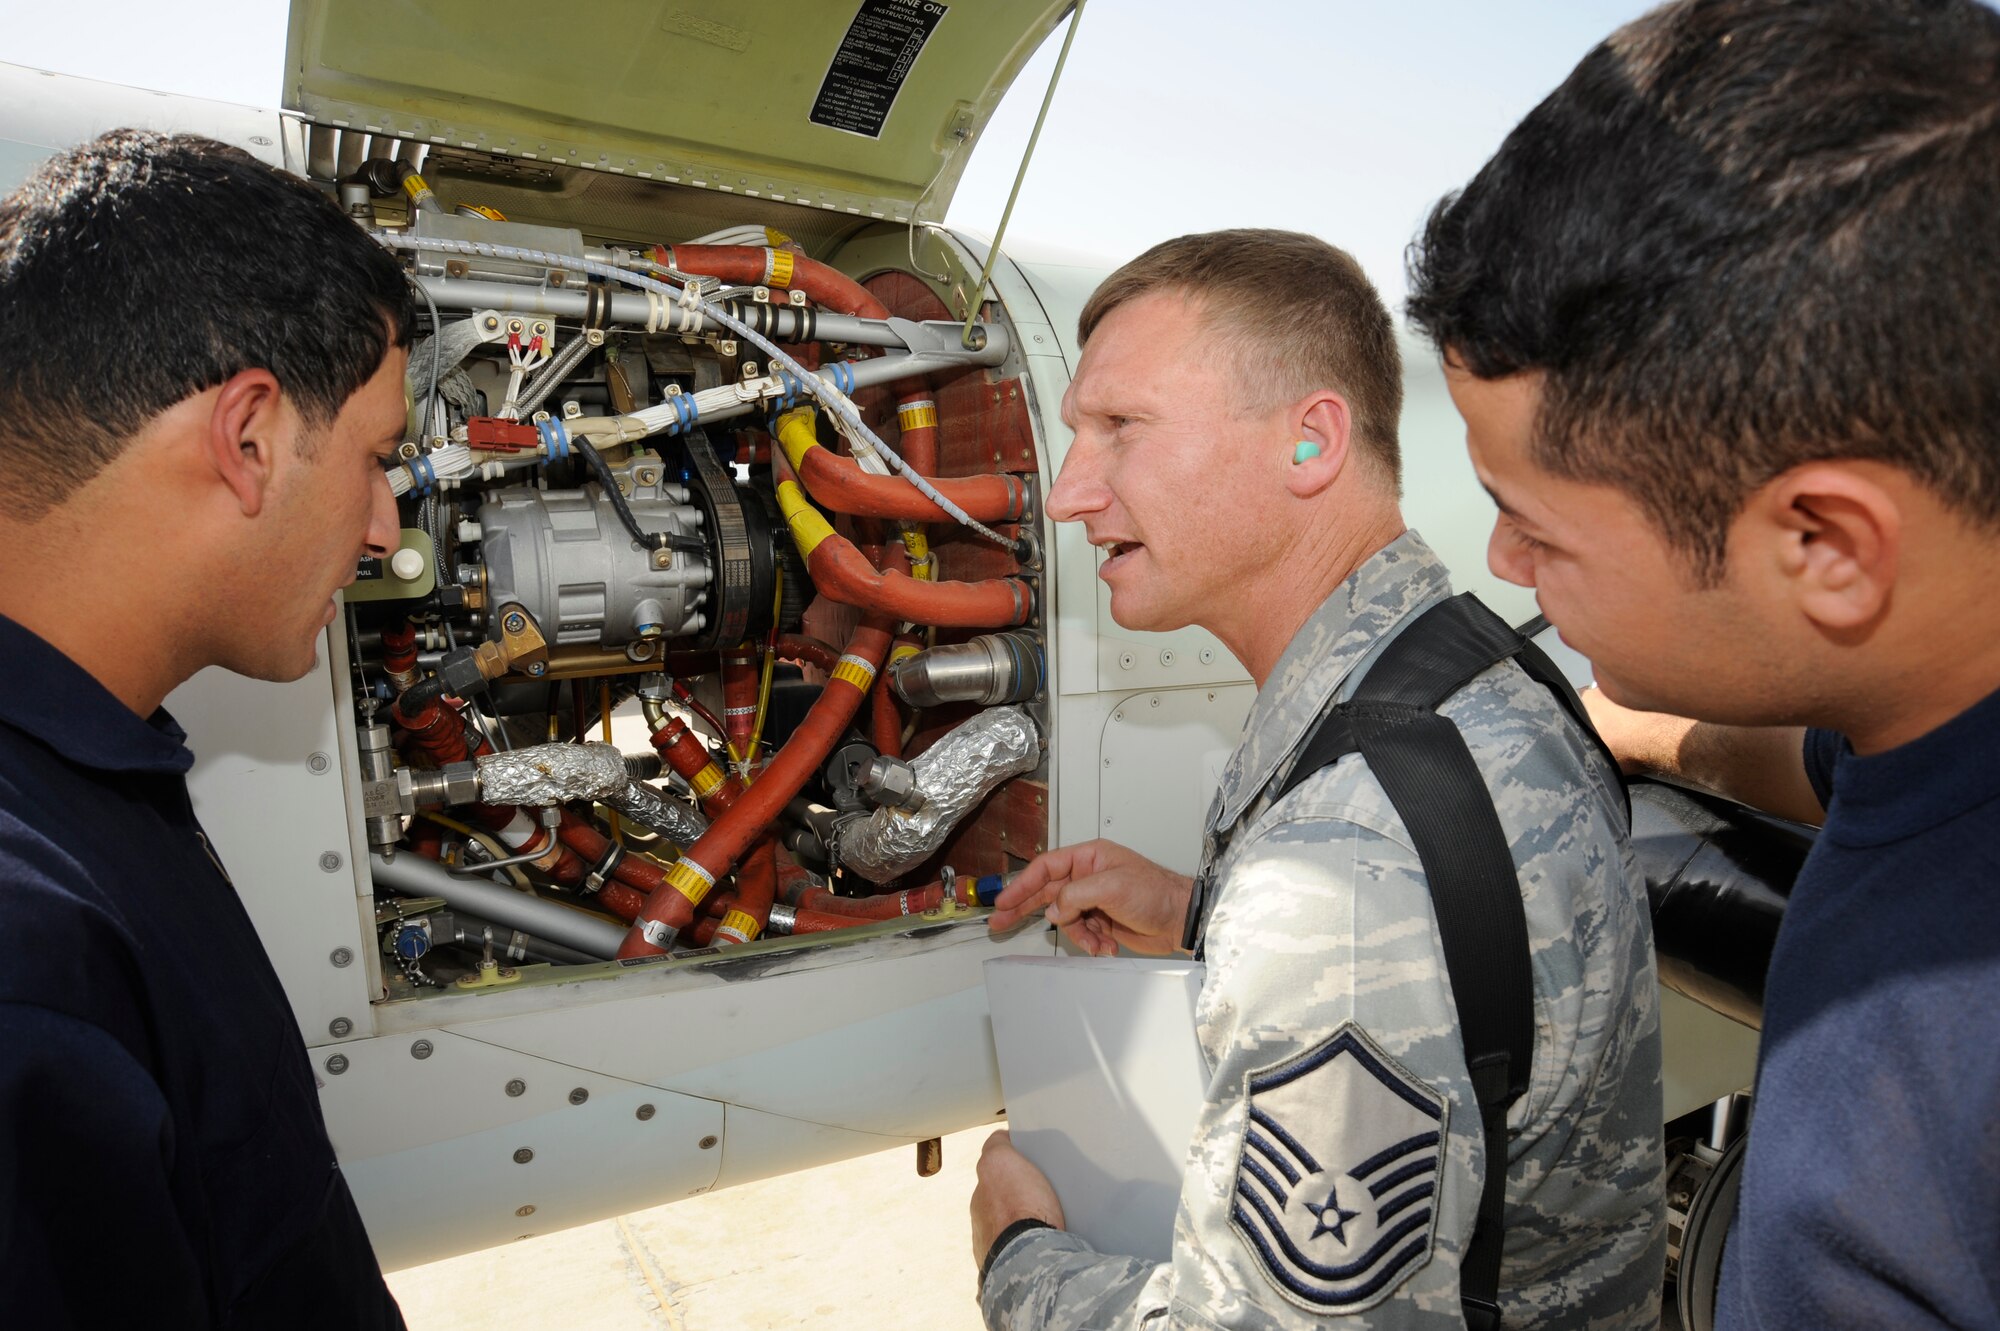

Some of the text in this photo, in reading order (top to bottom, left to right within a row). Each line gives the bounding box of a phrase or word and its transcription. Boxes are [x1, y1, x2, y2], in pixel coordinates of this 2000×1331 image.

[888, 3, 917, 17] SERVICE
[923, 3, 943, 16] OIL
[873, 6, 924, 25] INSTRUCTIONS
[855, 40, 876, 48] AIRCRAFT
[874, 48, 897, 57] APPROVED
[863, 64, 884, 73] AIRCRAFT
[874, 82, 895, 91] CAPACITY
[854, 88, 880, 98] GRADUATED
[868, 108, 884, 116] QUART
[656, 931, 672, 945] OIL
